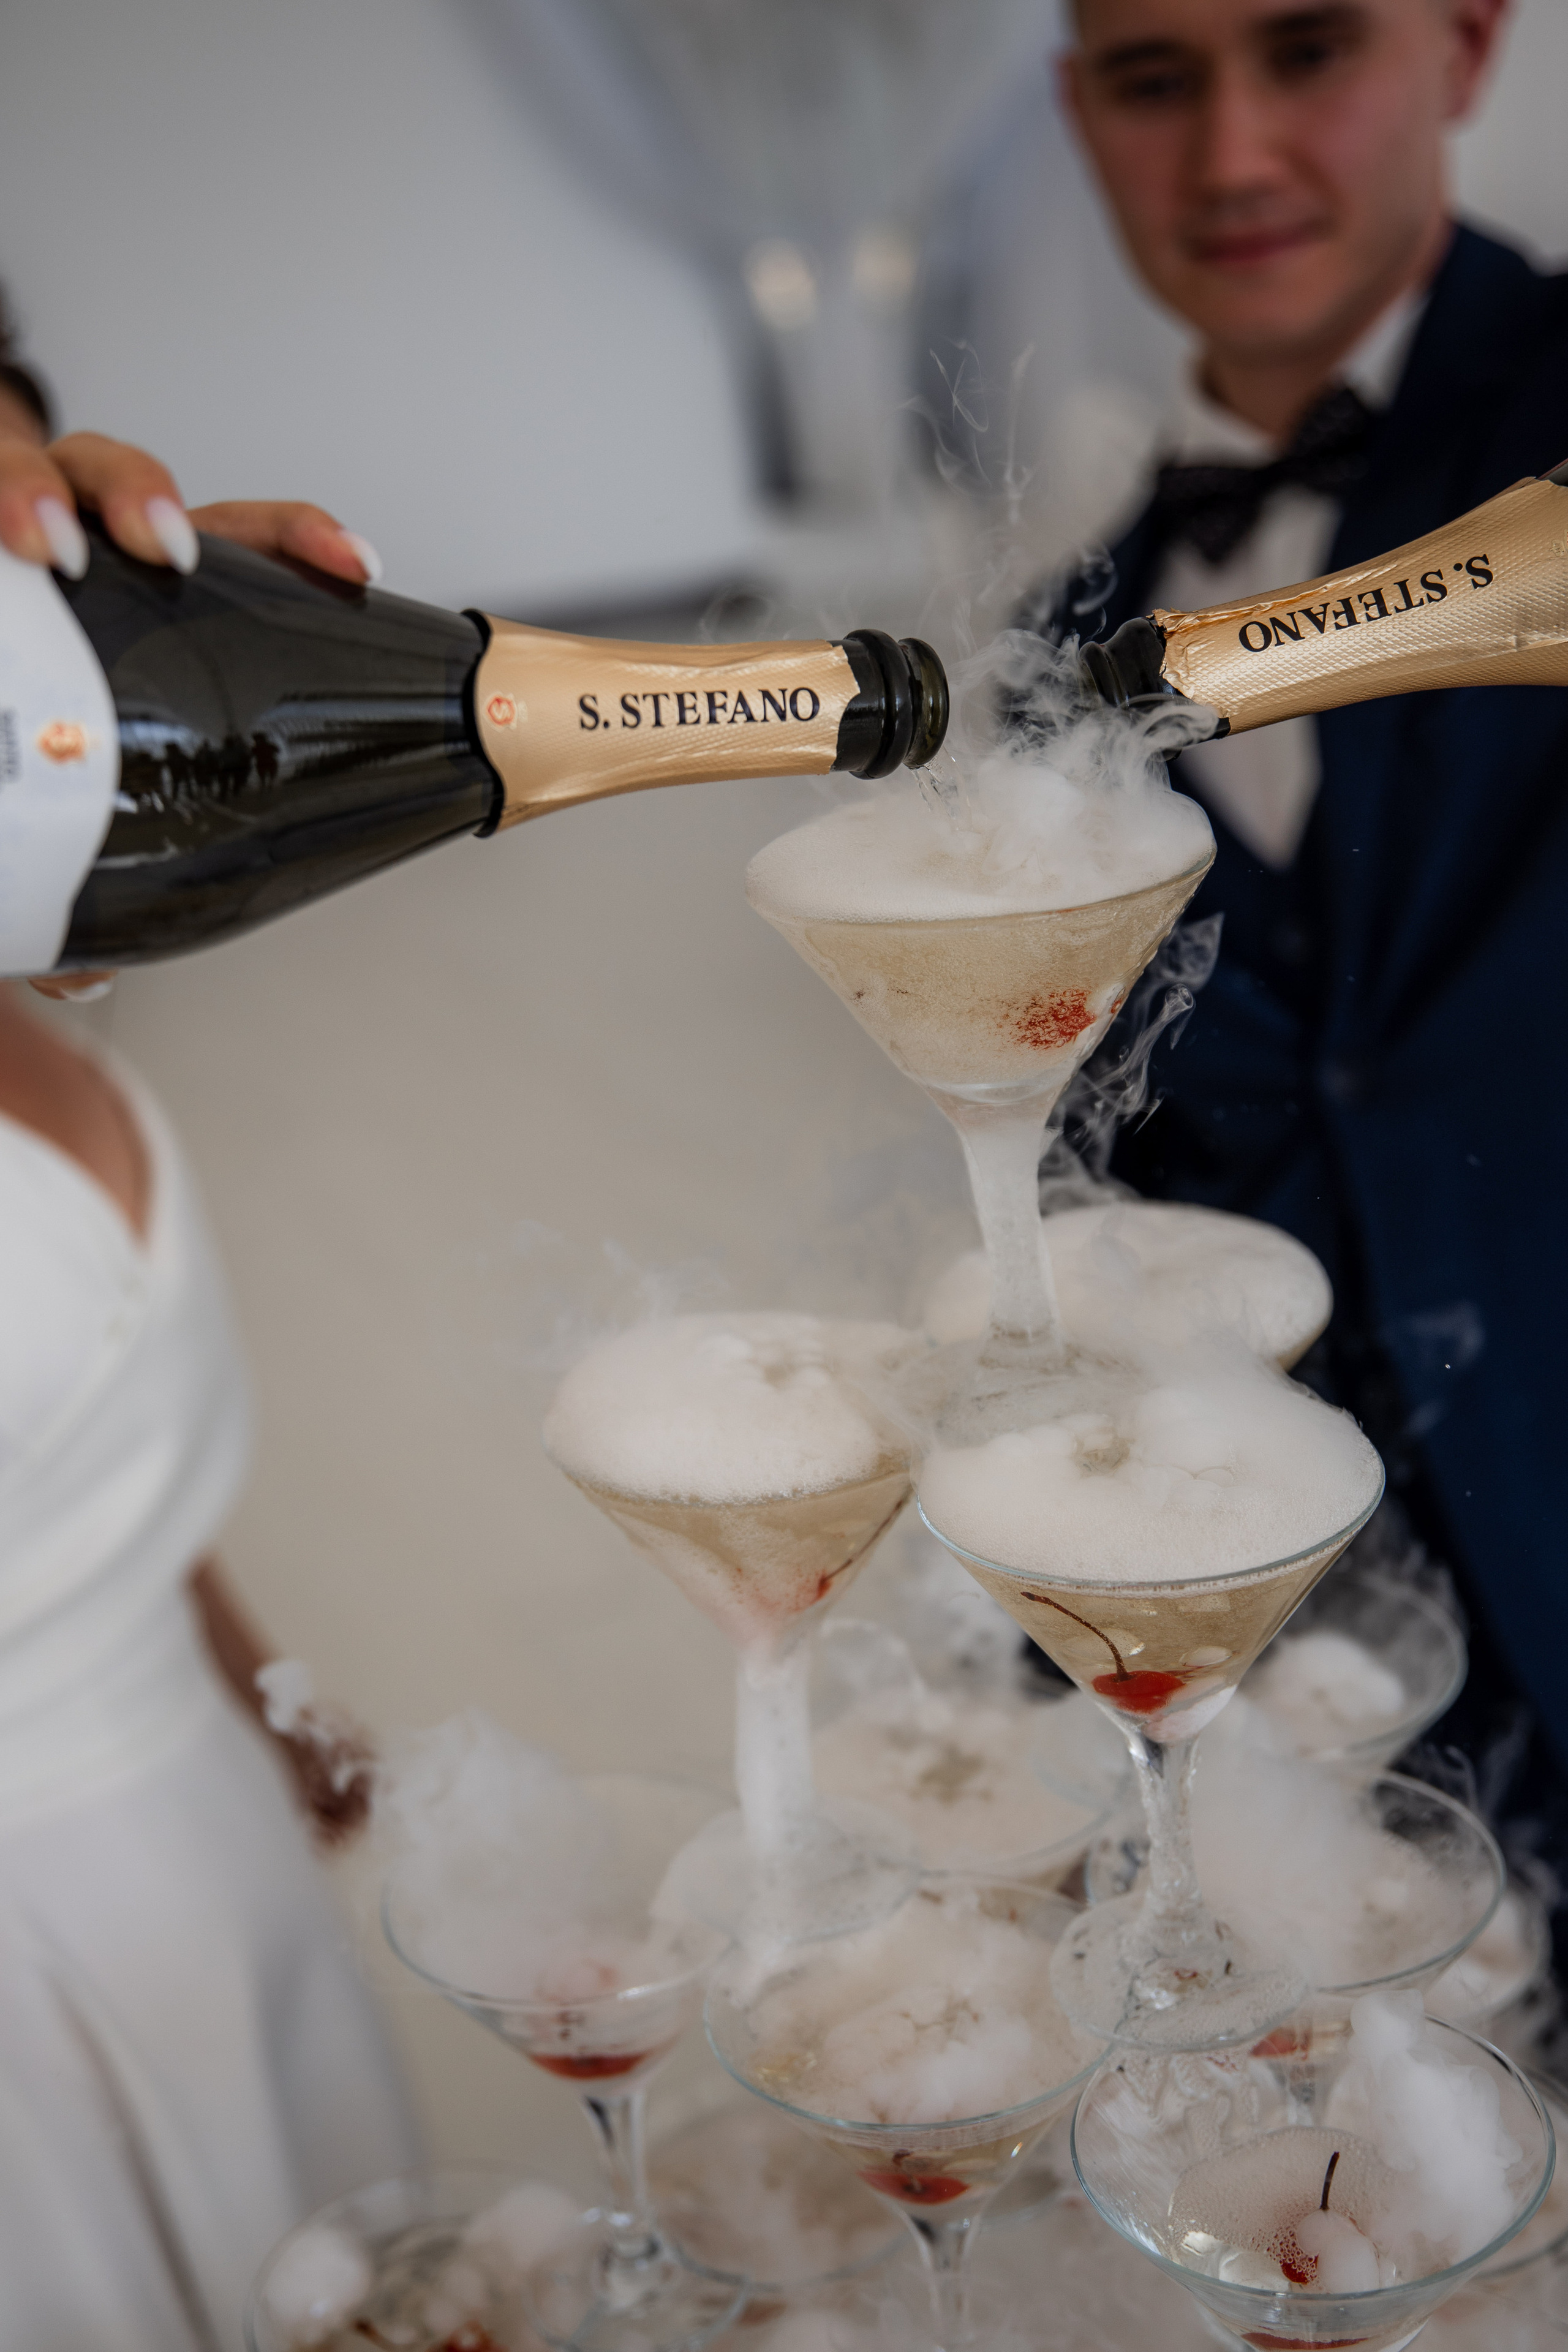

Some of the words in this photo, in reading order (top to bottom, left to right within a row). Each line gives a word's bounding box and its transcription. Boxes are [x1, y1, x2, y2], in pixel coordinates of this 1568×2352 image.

[1453, 554, 1494, 589] S.
[1238, 569, 1448, 652] STEFANO
[579, 694, 611, 730] S.
[620, 687, 820, 729] STEFANO
